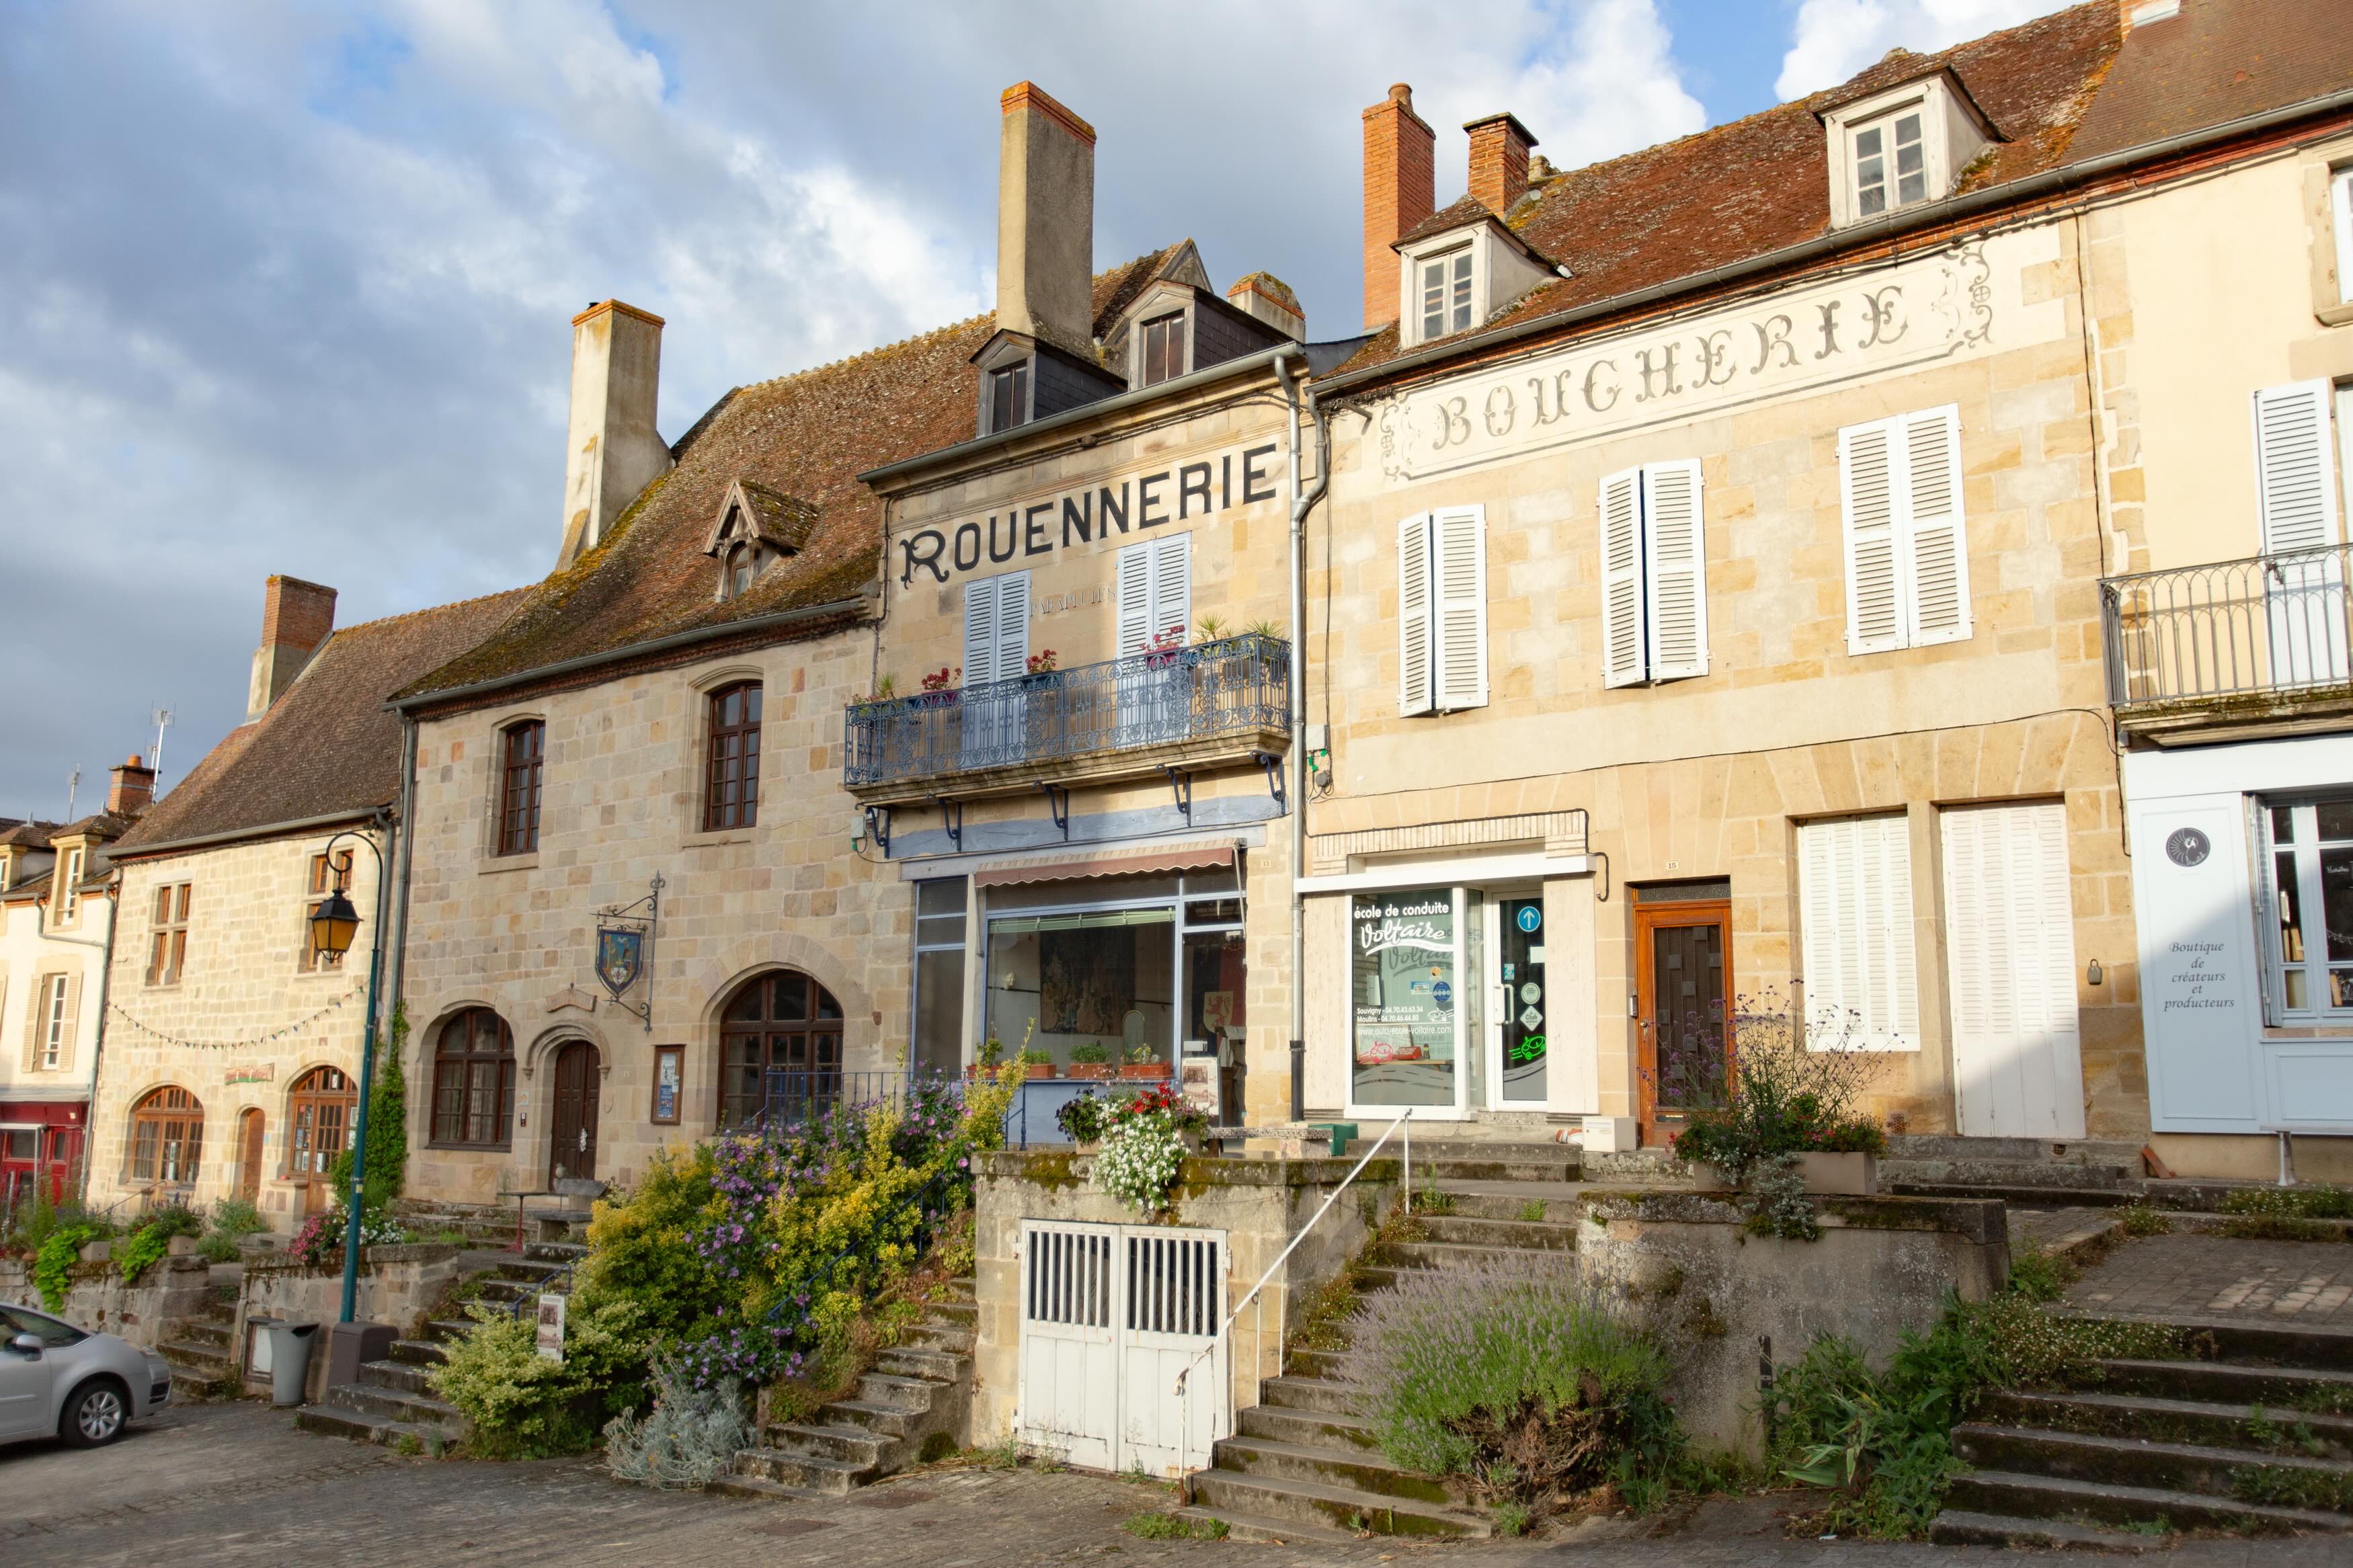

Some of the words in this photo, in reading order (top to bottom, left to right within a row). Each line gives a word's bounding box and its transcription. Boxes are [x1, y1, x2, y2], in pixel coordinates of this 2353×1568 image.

[1432, 285, 1909, 450] BOUCHERIE
[899, 443, 1277, 590] ROUENNERIE
[1354, 905, 1382, 919] école
[1385, 903, 1399, 917] de
[1402, 901, 1449, 915] conduite
[1361, 918, 1446, 949] Voltaire
[2169, 940, 2225, 955] Boutique
[2191, 956, 2205, 968] de
[2171, 971, 2226, 983] créateurs
[2192, 985, 2202, 994] et
[1357, 1007, 1382, 1016] Souvigny
[2163, 996, 2235, 1012] producteurs
